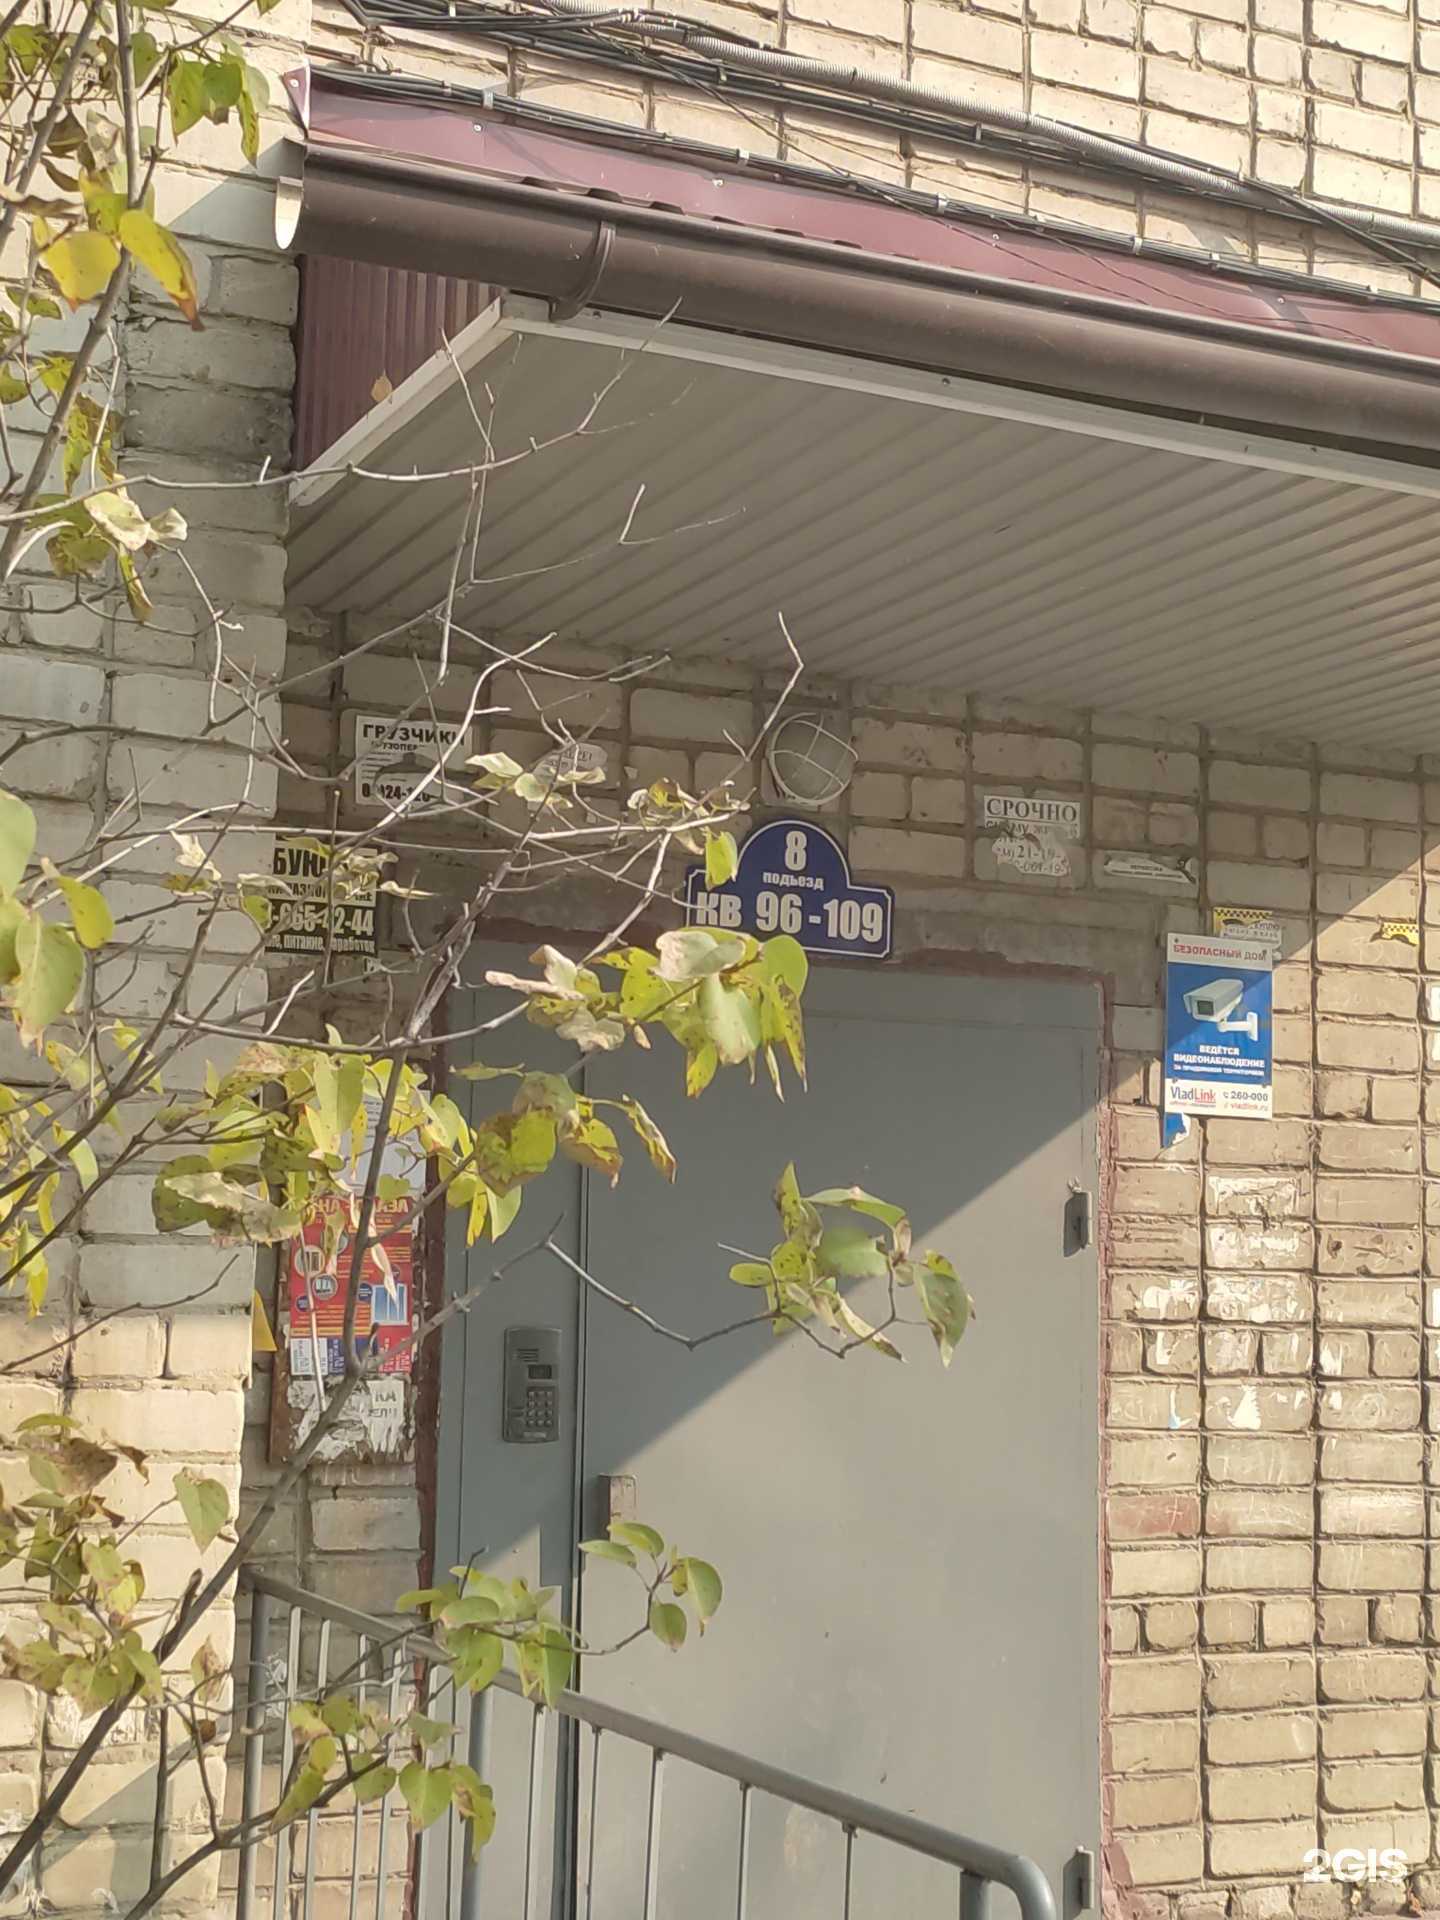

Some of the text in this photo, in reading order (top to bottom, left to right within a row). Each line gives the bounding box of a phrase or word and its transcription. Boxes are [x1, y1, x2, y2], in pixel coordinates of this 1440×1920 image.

[987, 798, 1077, 822] СРОЧНО
[785, 831, 807, 871] 8
[696, 891, 742, 927] КВ
[1173, 944, 1242, 960] БЕЗОПАСНЫЙ
[1173, 1053, 1265, 1069] ВИДЕОНАБЛЮДЕНИЕ
[1170, 1085, 1216, 1102] VladLink
